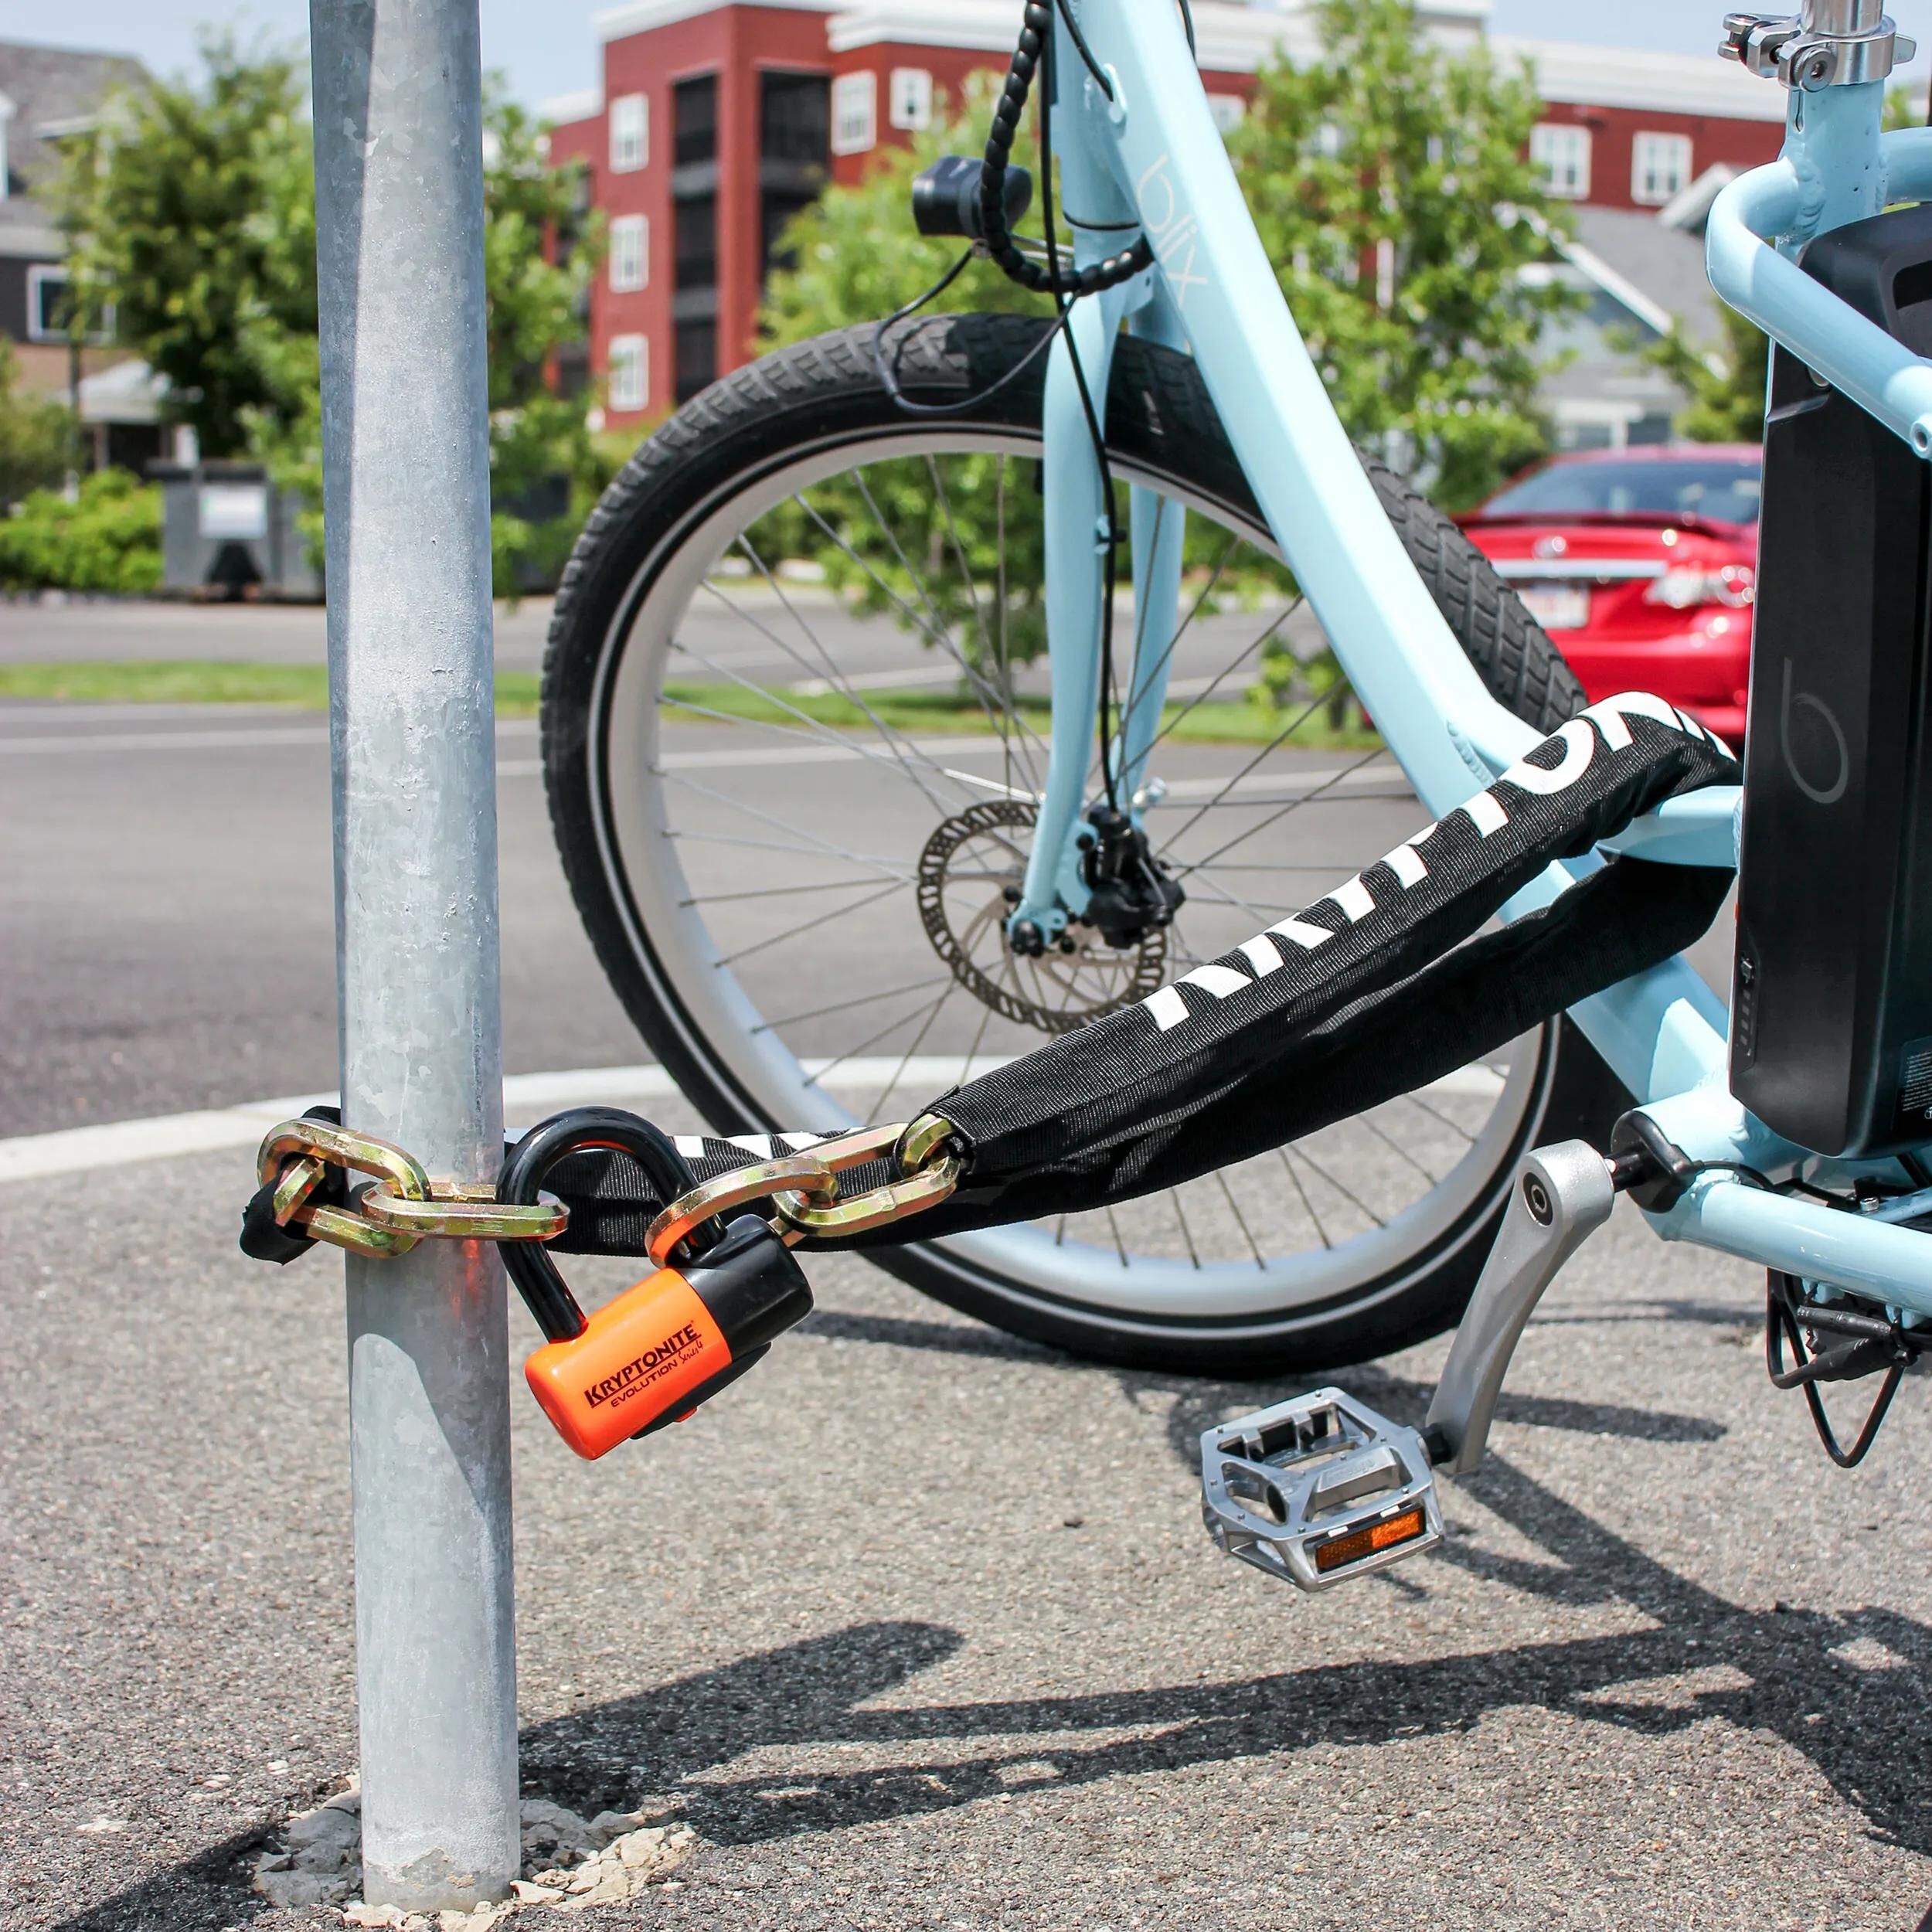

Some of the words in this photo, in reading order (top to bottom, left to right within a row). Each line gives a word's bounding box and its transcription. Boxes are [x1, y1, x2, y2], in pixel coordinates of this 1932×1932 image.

[1137, 153, 1208, 308] blix
[583, 1323, 698, 1407] KRYPTONITE
[610, 1359, 678, 1407] EVOLUTION
